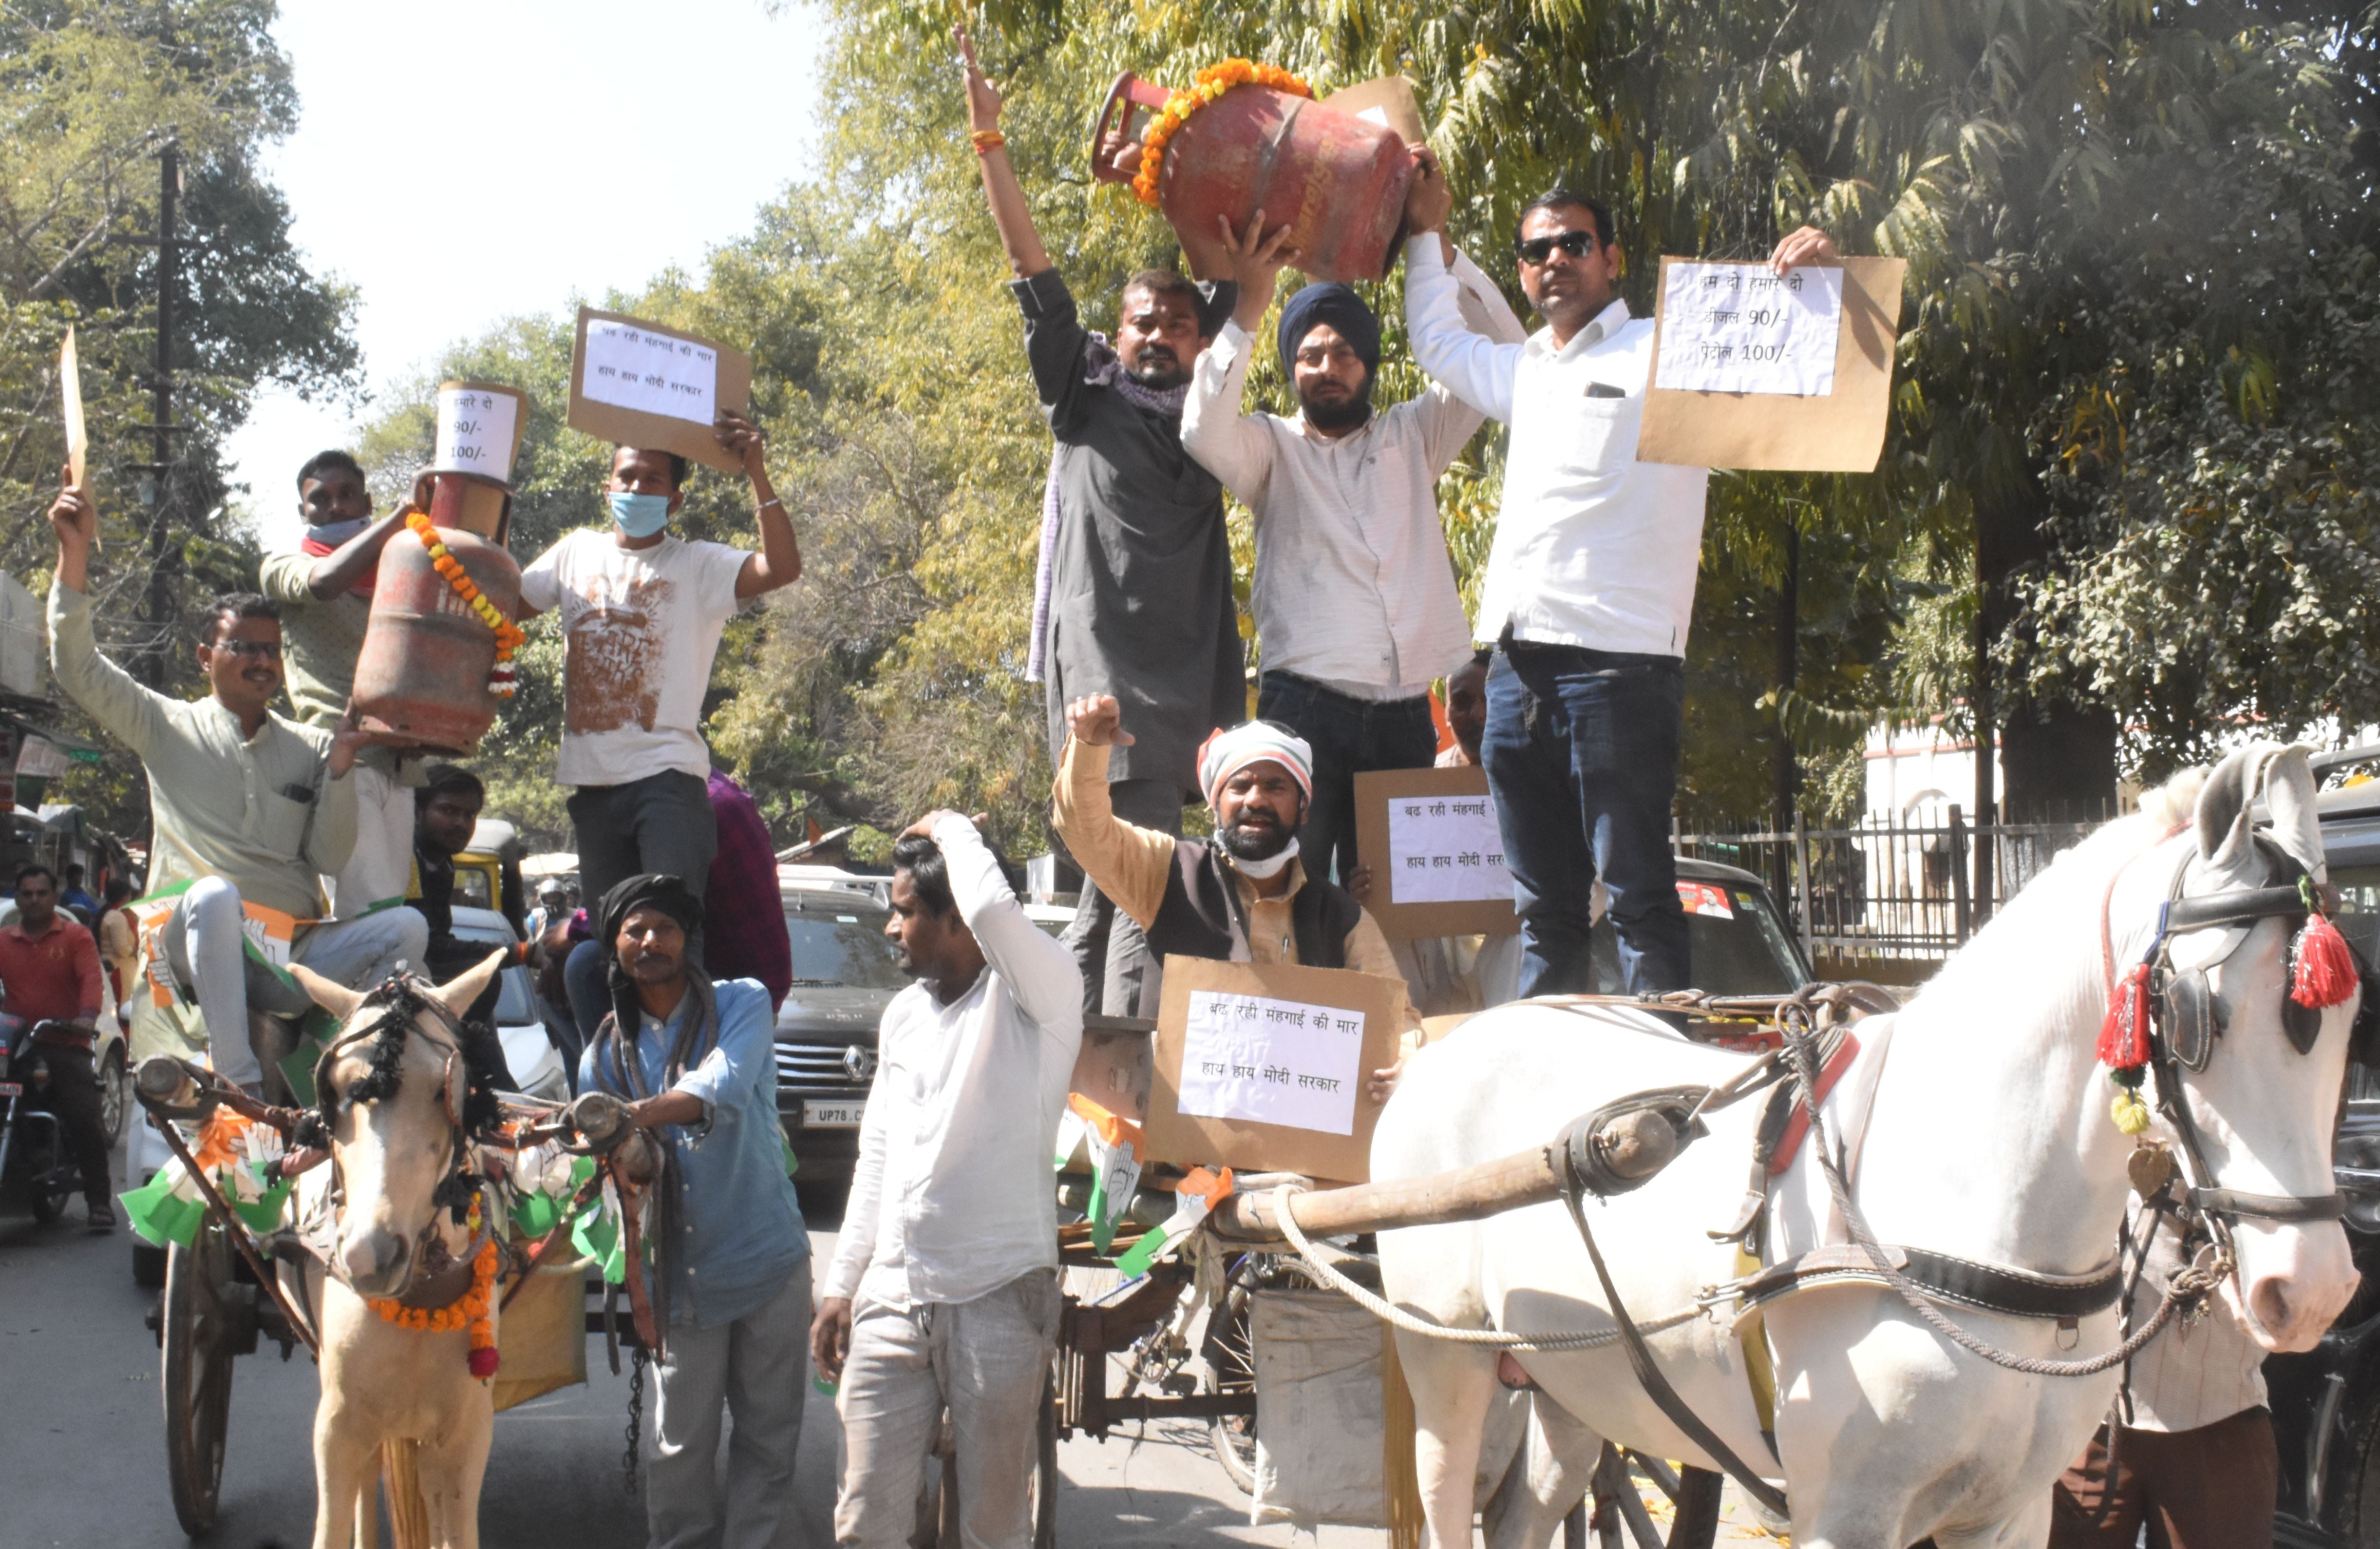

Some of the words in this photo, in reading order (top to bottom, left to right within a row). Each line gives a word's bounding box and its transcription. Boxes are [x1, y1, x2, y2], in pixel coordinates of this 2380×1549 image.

[1700, 275, 1717, 290] हम
[1727, 272, 1740, 290] दो
[1749, 274, 1782, 292] हमारे
[1789, 273, 1803, 292] दो
[1703, 308, 1739, 325] डीजल
[1749, 309, 1788, 328] 90/-
[1700, 341, 1733, 360] पेट्रोल
[1742, 344, 1792, 363] 100/-
[483, 396, 492, 410] दो
[453, 421, 482, 435] 90/-
[452, 447, 486, 460] 100/-
[1429, 802, 1446, 817] रही
[1453, 800, 1486, 817] मंहगाई
[1407, 857, 1425, 867] हाय
[1433, 857, 1451, 867] हाय
[1458, 852, 1480, 866] मोदी
[1238, 1003, 1257, 1019] रही
[1266, 1006, 1306, 1028] मंहगाई
[1313, 1012, 1328, 1031] की
[1337, 1020, 1359, 1035] मार
[1202, 1062, 1225, 1076] हाय
[1233, 1065, 1255, 1081] हाय
[1264, 1065, 1291, 1085] मोदी
[1298, 1075, 1341, 1094] सरकार
